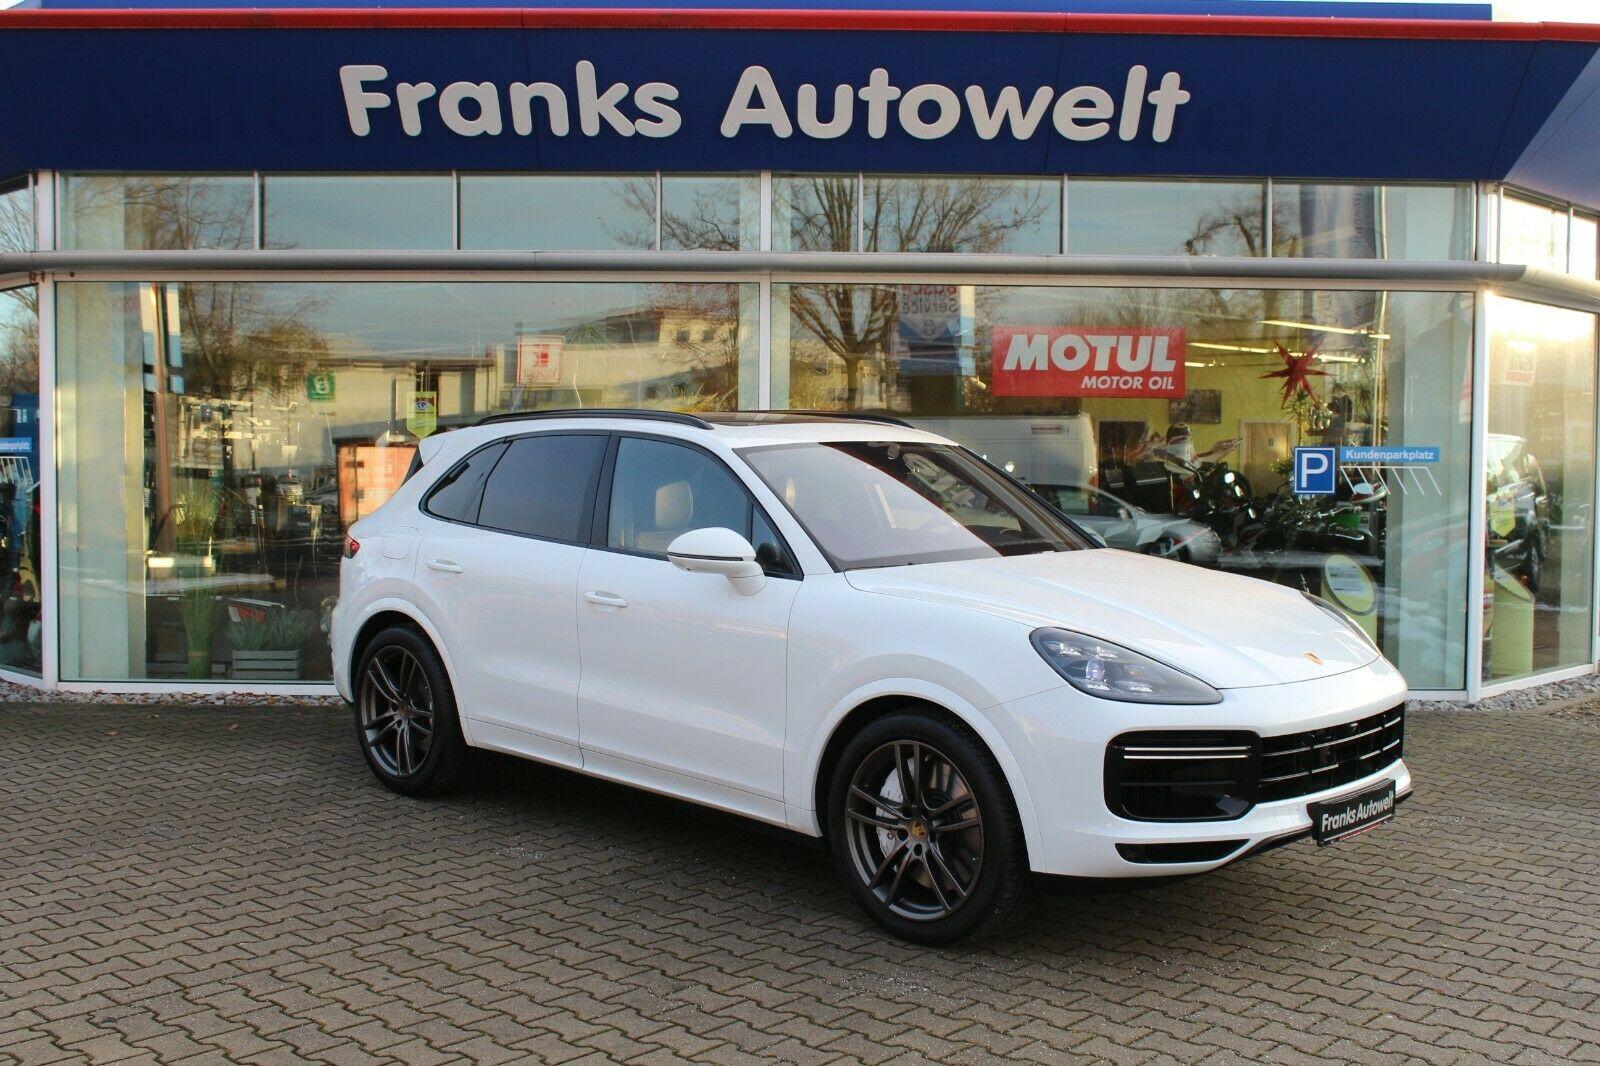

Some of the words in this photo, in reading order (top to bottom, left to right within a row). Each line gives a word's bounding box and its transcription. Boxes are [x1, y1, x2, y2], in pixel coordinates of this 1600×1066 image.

[339, 60, 682, 138] Franks
[720, 64, 1191, 143] Autowelt
[1002, 333, 1176, 372] MOTUL
[1081, 376, 1143, 390] MOTOR
[1148, 376, 1175, 390] OIL
[1301, 452, 1329, 488] P
[1346, 449, 1434, 461] Kundenparkplatz
[1321, 806, 1358, 833] Franks
[1356, 790, 1395, 821] Autowelt
